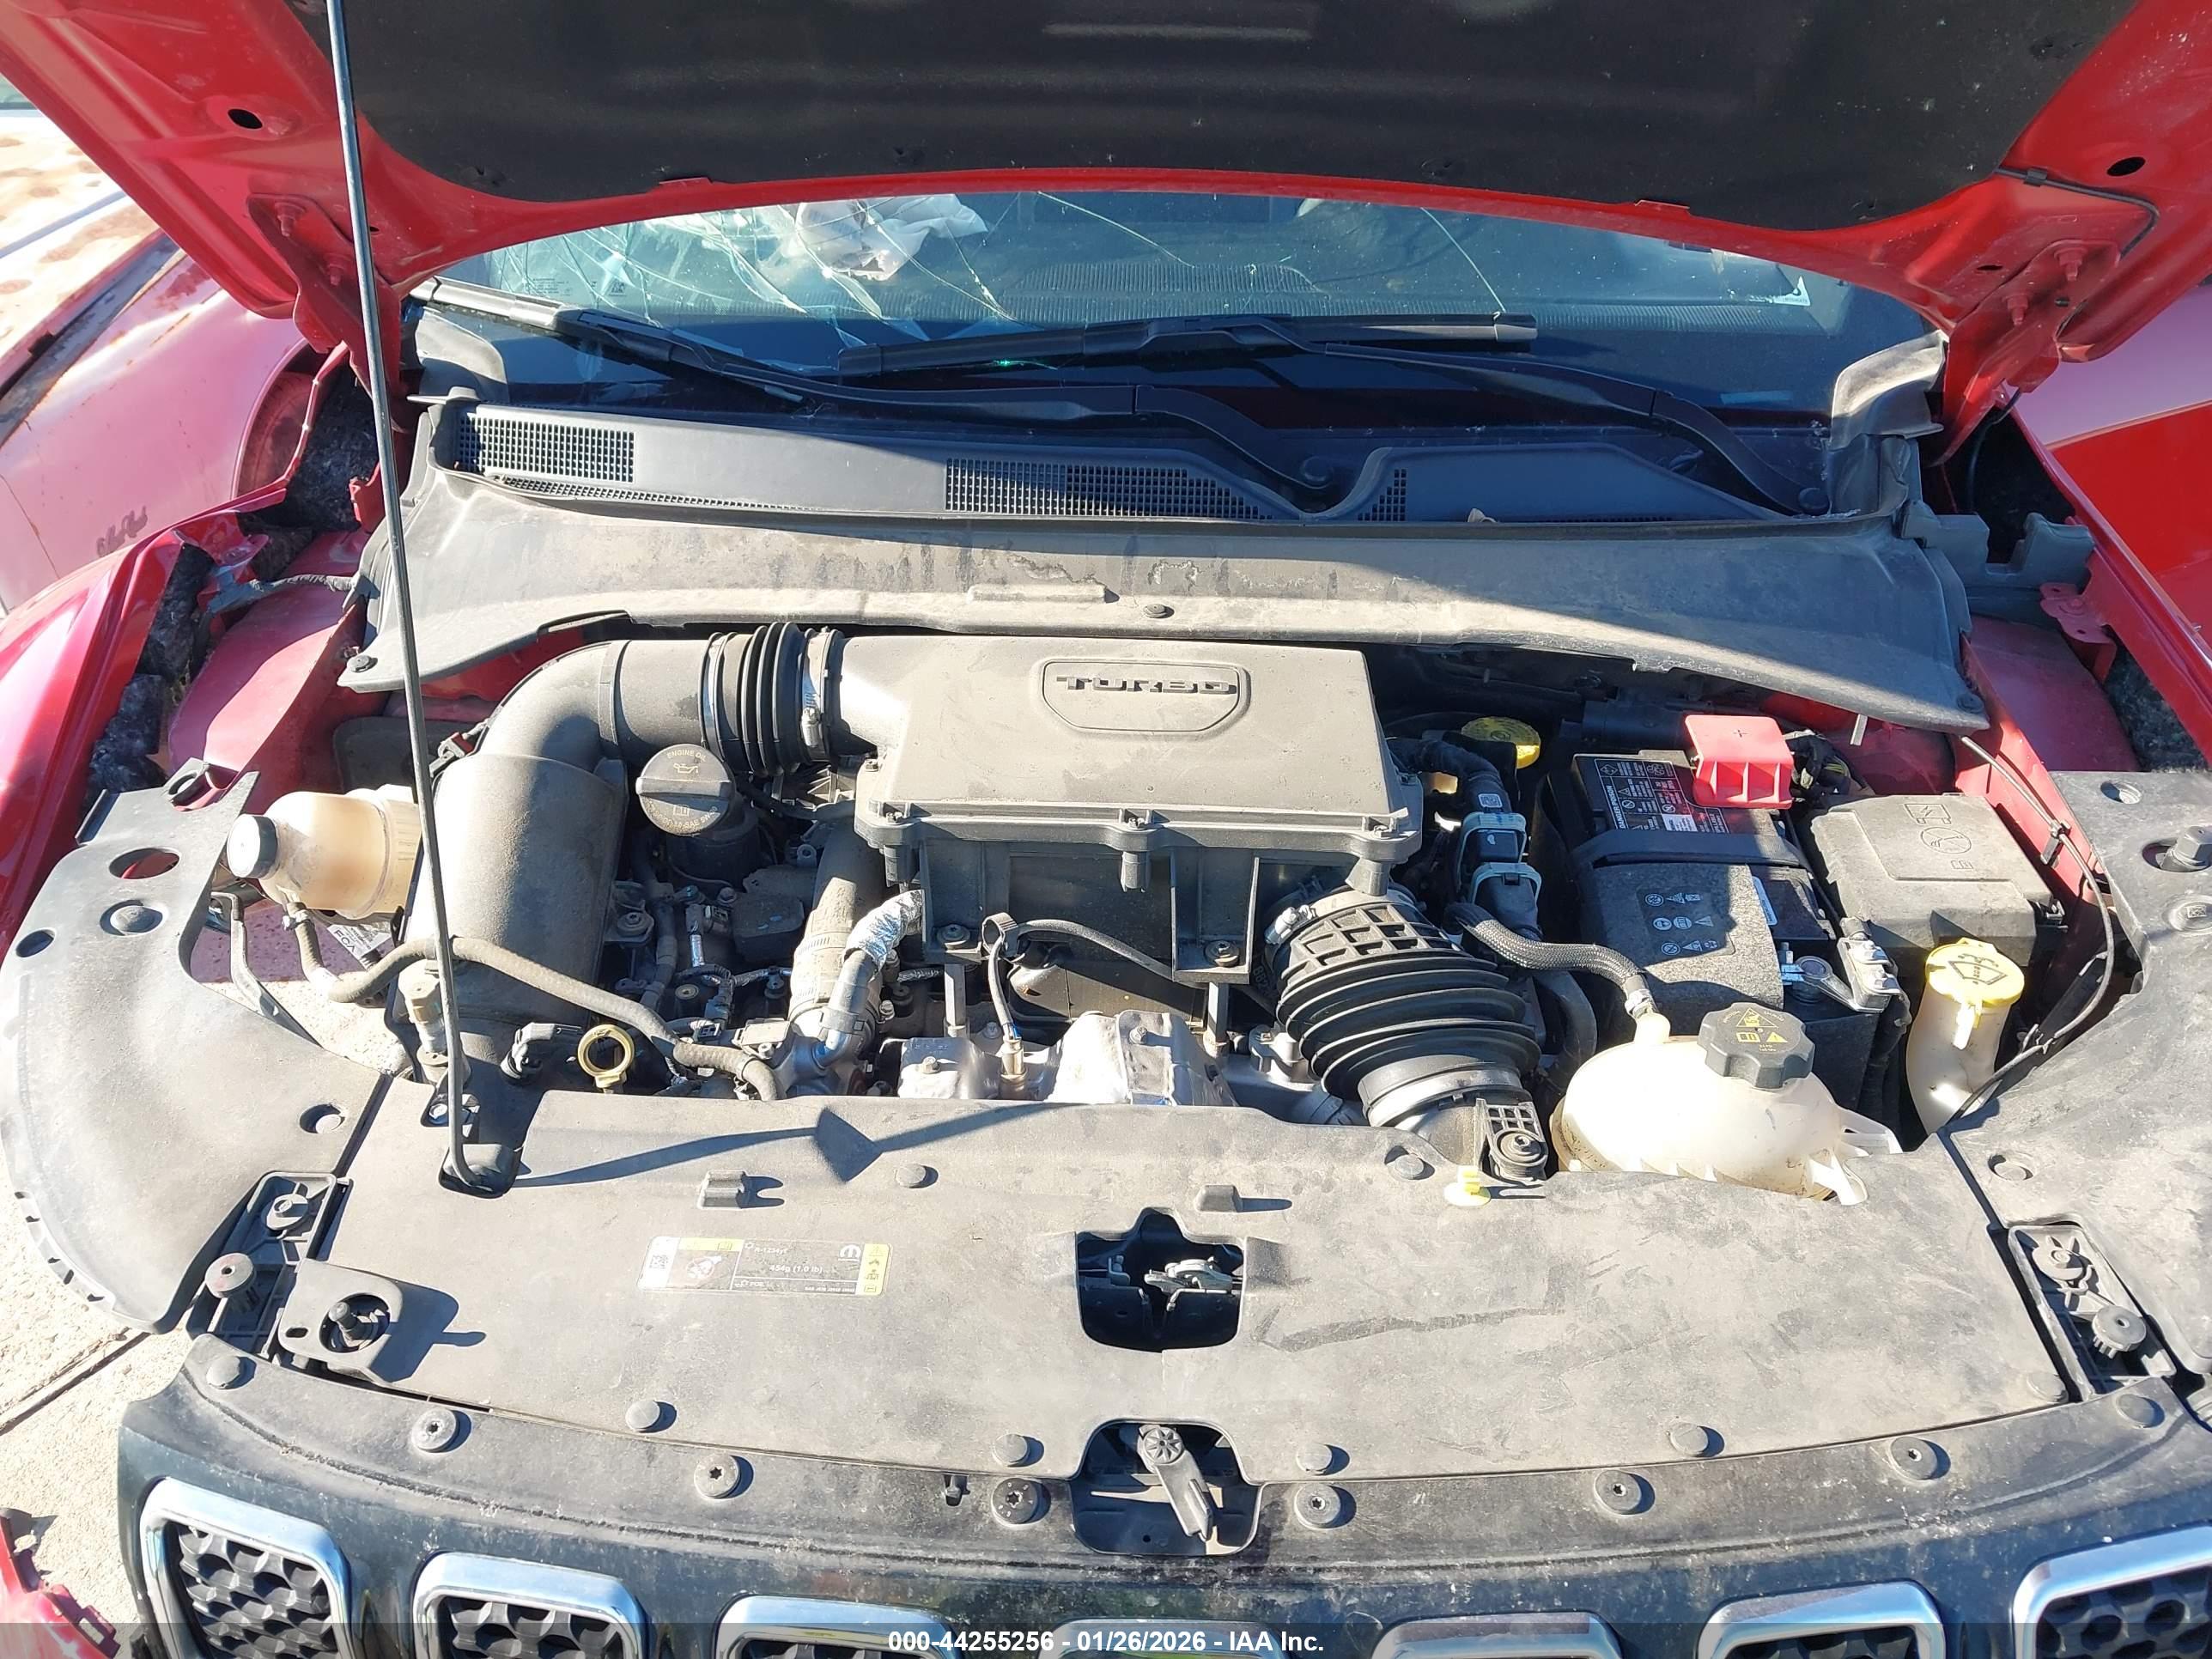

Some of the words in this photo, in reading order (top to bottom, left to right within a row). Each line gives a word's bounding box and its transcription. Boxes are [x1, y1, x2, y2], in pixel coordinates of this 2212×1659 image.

[1056, 676, 1237, 694] TURBO
[666, 750, 694, 759] ENGINE
[1607, 784, 1628, 830] DANGER/POISON
[333, 929, 356, 952] FCA
[769, 1264, 791, 1273] 454g
